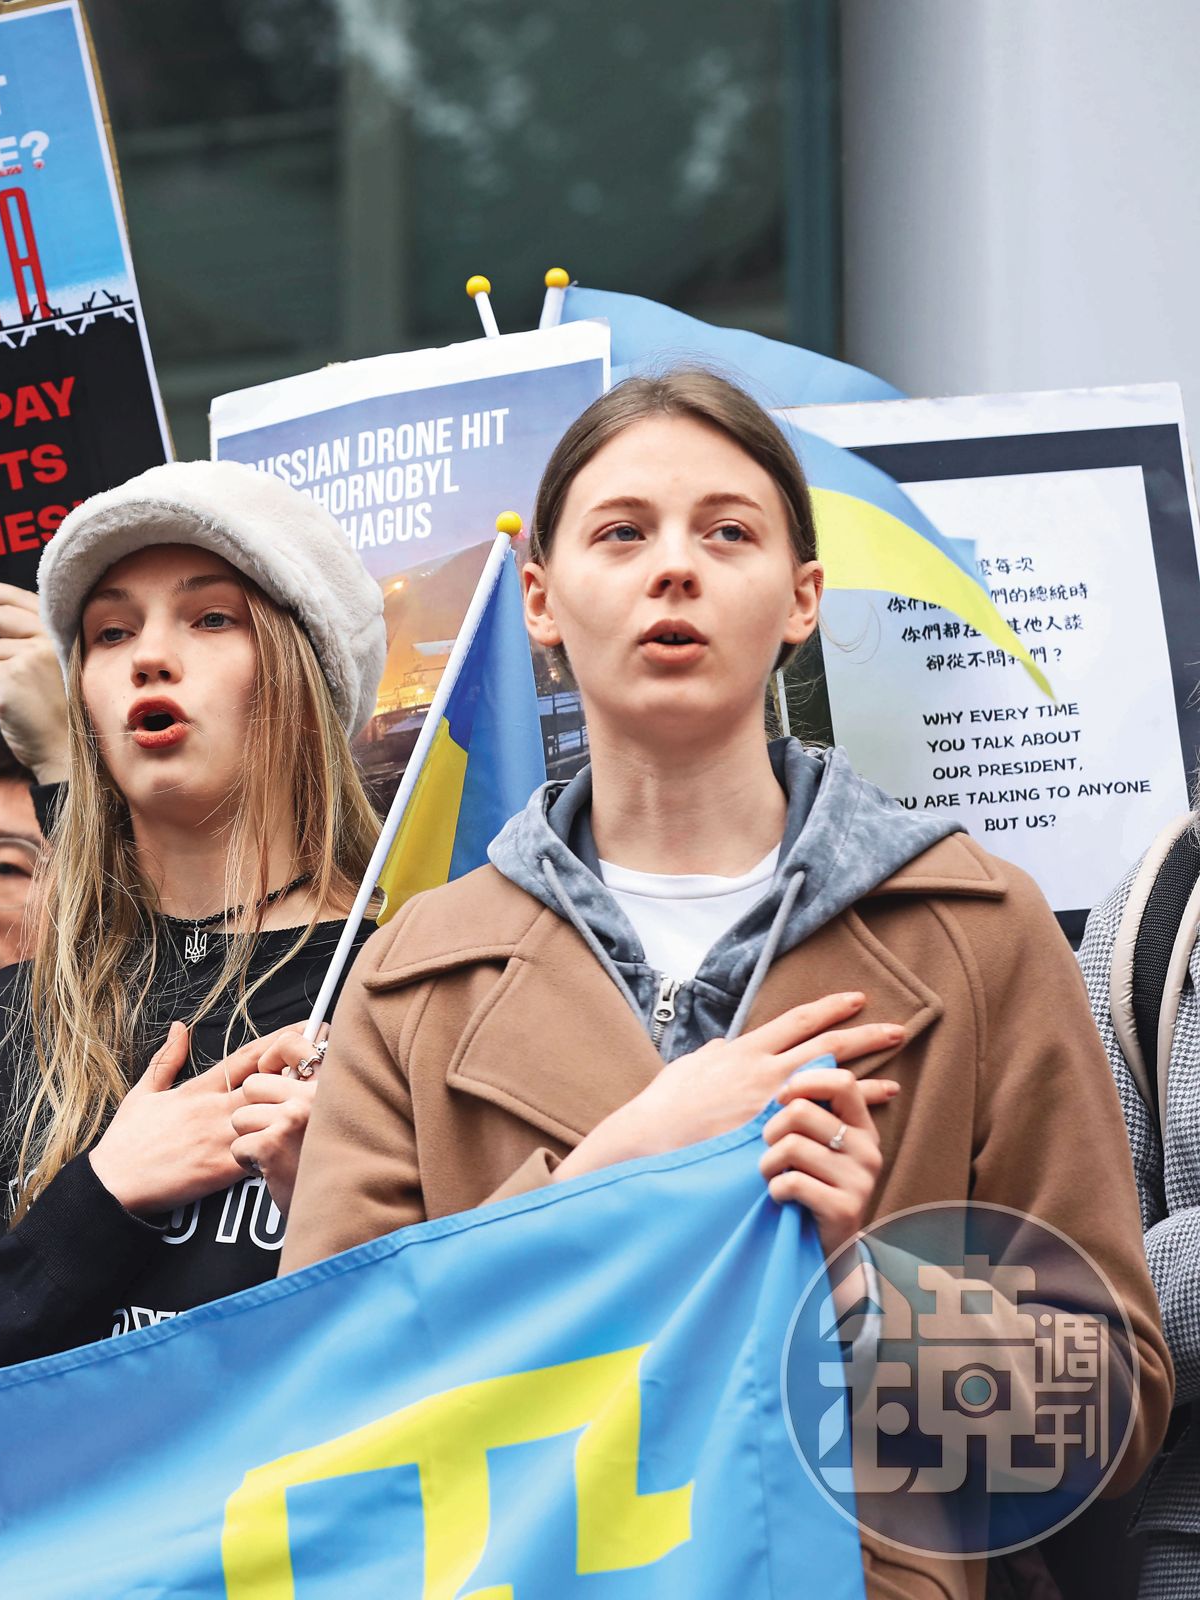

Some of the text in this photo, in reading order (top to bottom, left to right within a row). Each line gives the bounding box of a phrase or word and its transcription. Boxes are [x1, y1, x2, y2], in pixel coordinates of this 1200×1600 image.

[357, 417, 453, 468] DRONE
[461, 408, 509, 450] HIT
[299, 458, 460, 516] HORNOBYL
[340, 502, 432, 550] HAGUS
[976, 556, 1035, 576] 麼每次
[922, 703, 1080, 726] WHY EVERY TIME
[926, 730, 1081, 753] YOU TALK ABOUT
[932, 757, 1083, 780] OUR PRESIDENT,
[924, 793, 960, 808] ARE
[966, 787, 1040, 805] TALKING
[1046, 785, 1070, 799] TO
[1077, 780, 1151, 797] ANYONE
[984, 814, 1057, 832] BUT US?
